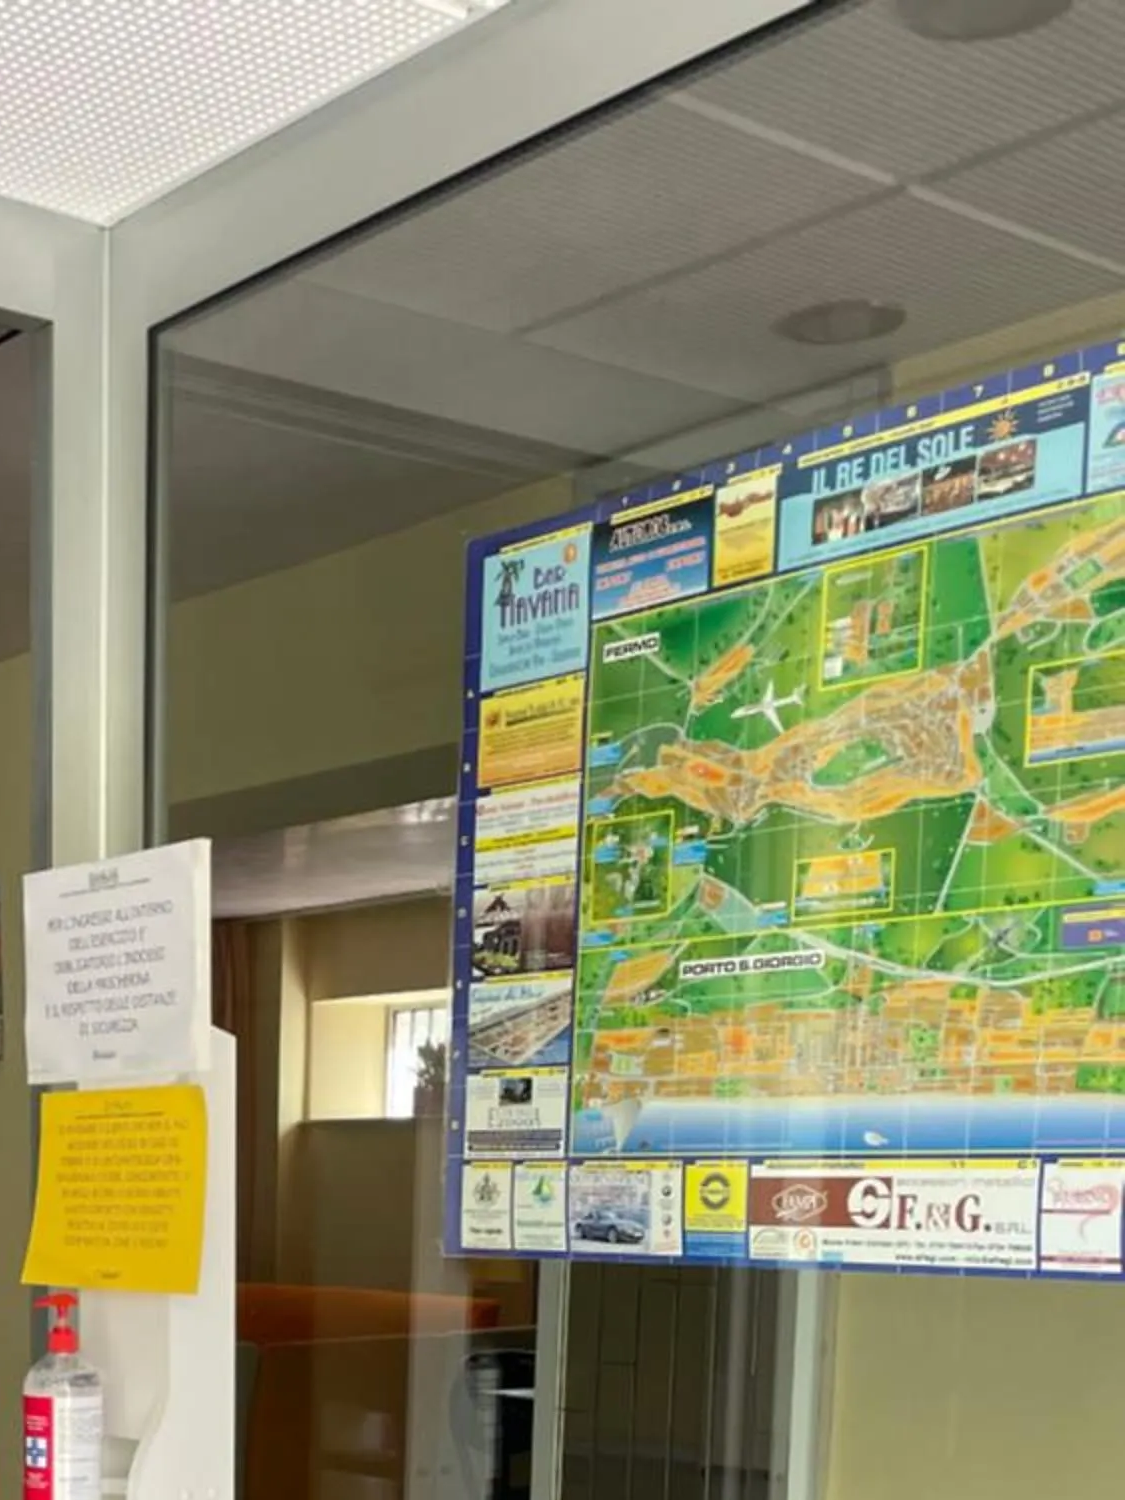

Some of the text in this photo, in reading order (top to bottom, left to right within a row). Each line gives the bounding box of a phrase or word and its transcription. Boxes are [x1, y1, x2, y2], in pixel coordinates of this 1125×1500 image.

[835, 456, 866, 490] RE
[870, 443, 911, 481] DEL
[917, 425, 975, 467] SOLE
[606, 636, 658, 658] FERMO
[682, 961, 736, 975] PORTO
[753, 953, 822, 970] GIORGIO
